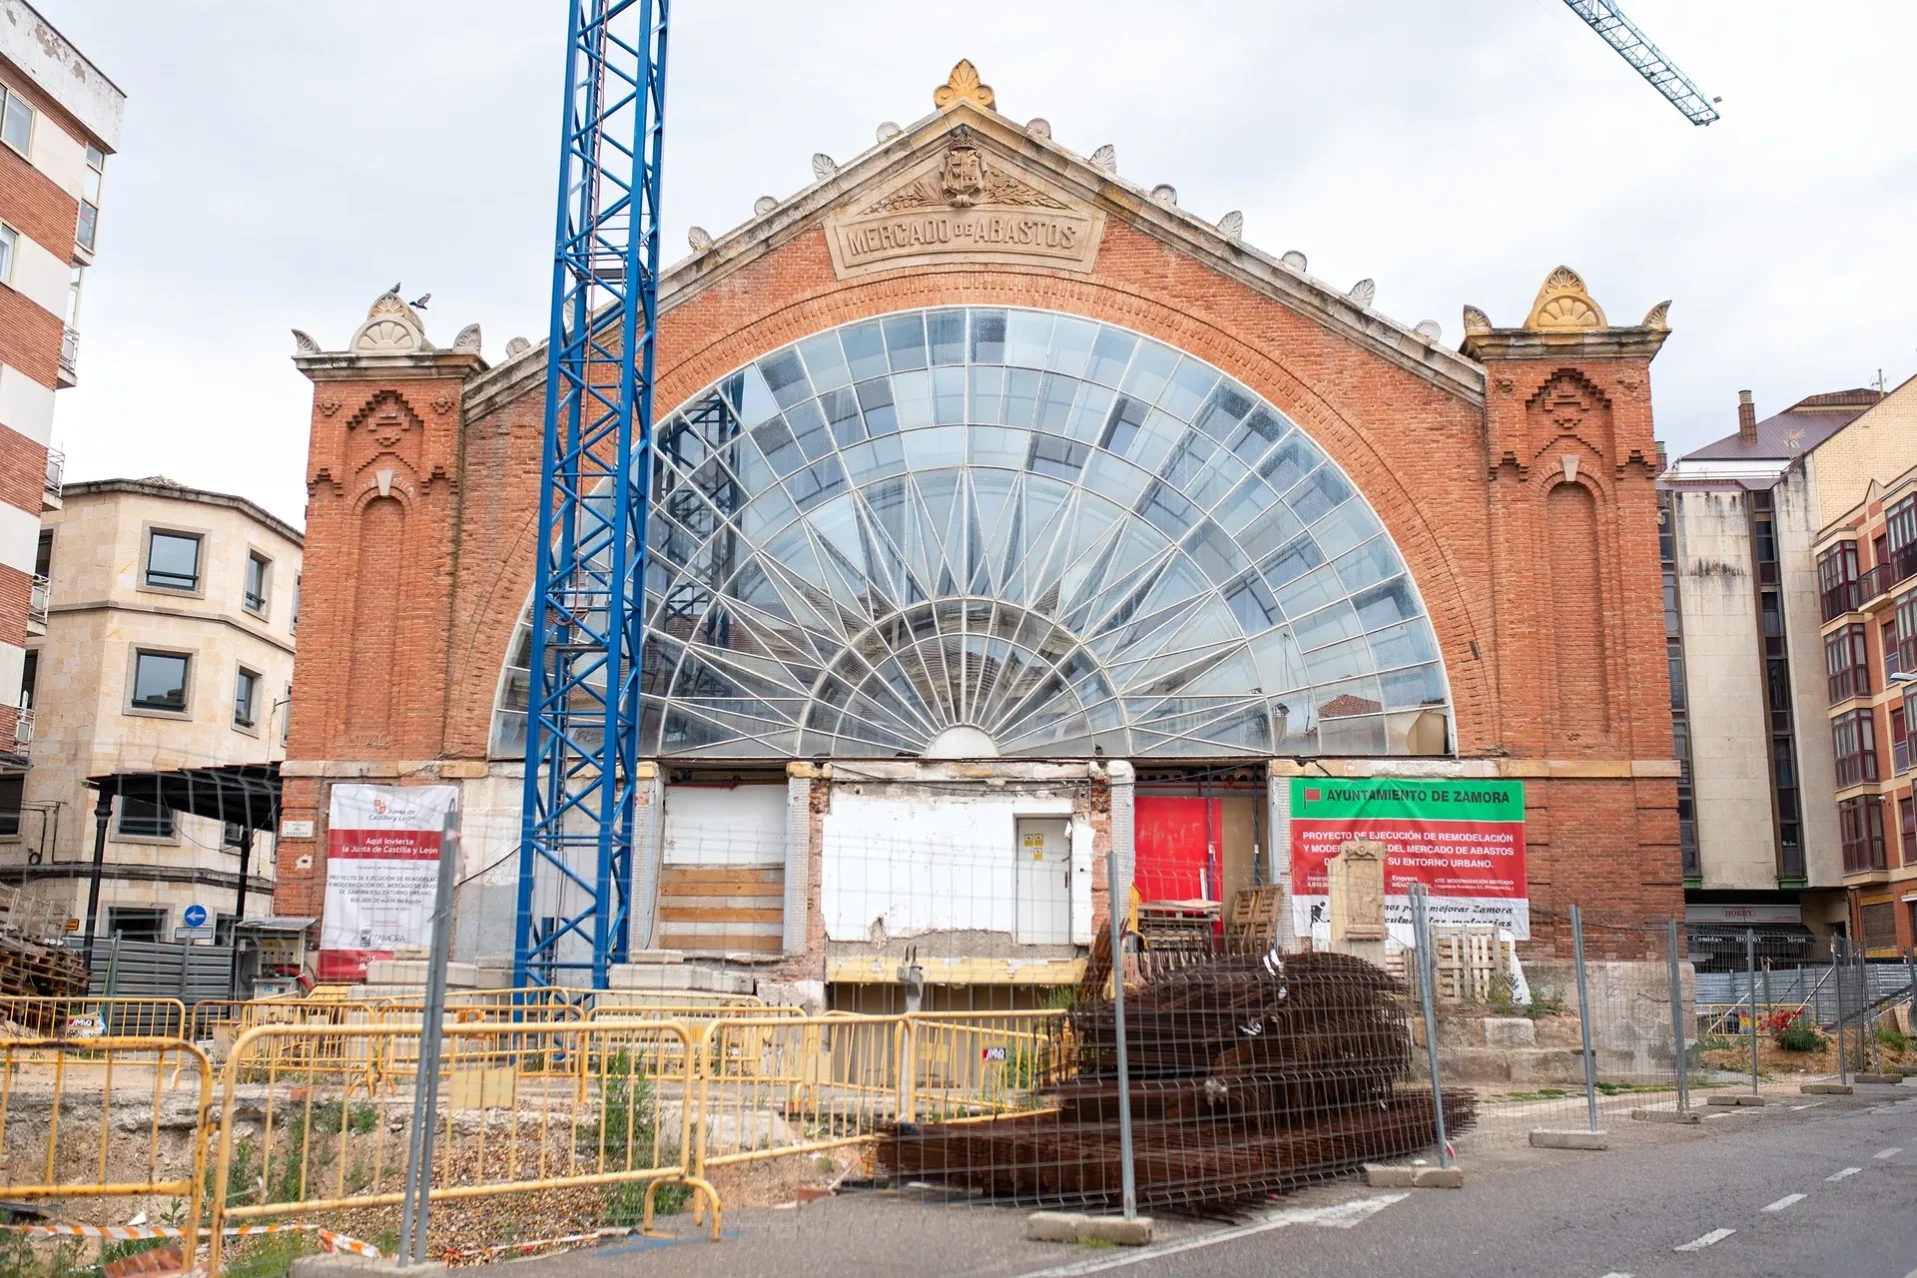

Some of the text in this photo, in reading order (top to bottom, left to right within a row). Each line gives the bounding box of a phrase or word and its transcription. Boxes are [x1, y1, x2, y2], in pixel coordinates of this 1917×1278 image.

[847, 218, 1076, 256] MERCADO DE ABASTOS
[1327, 788, 1511, 804] AYUNTAMIENTO DE ZAMORA
[1302, 831, 1352, 840] PROYECTO
[1369, 830, 1421, 841] EJECUCIÓN
[1423, 832, 1436, 841] DE
[1438, 832, 1514, 843] REMODELACIÓN
[419, 846, 438, 854] León
[1303, 845, 1310, 853] Y
[1387, 844, 1405, 853] DEL
[1407, 845, 1454, 854] MERCADO
[1456, 846, 1469, 854] DE
[1470, 846, 1514, 856] ABASTOS
[1388, 857, 1401, 866] SU
[1403, 858, 1448, 867] ENTORNO
[1450, 859, 1494, 868] URBANO.
[1429, 905, 1470, 914] mejorar
[1473, 905, 1513, 914] Zamora
[1725, 909, 1753, 917] HOBBY
